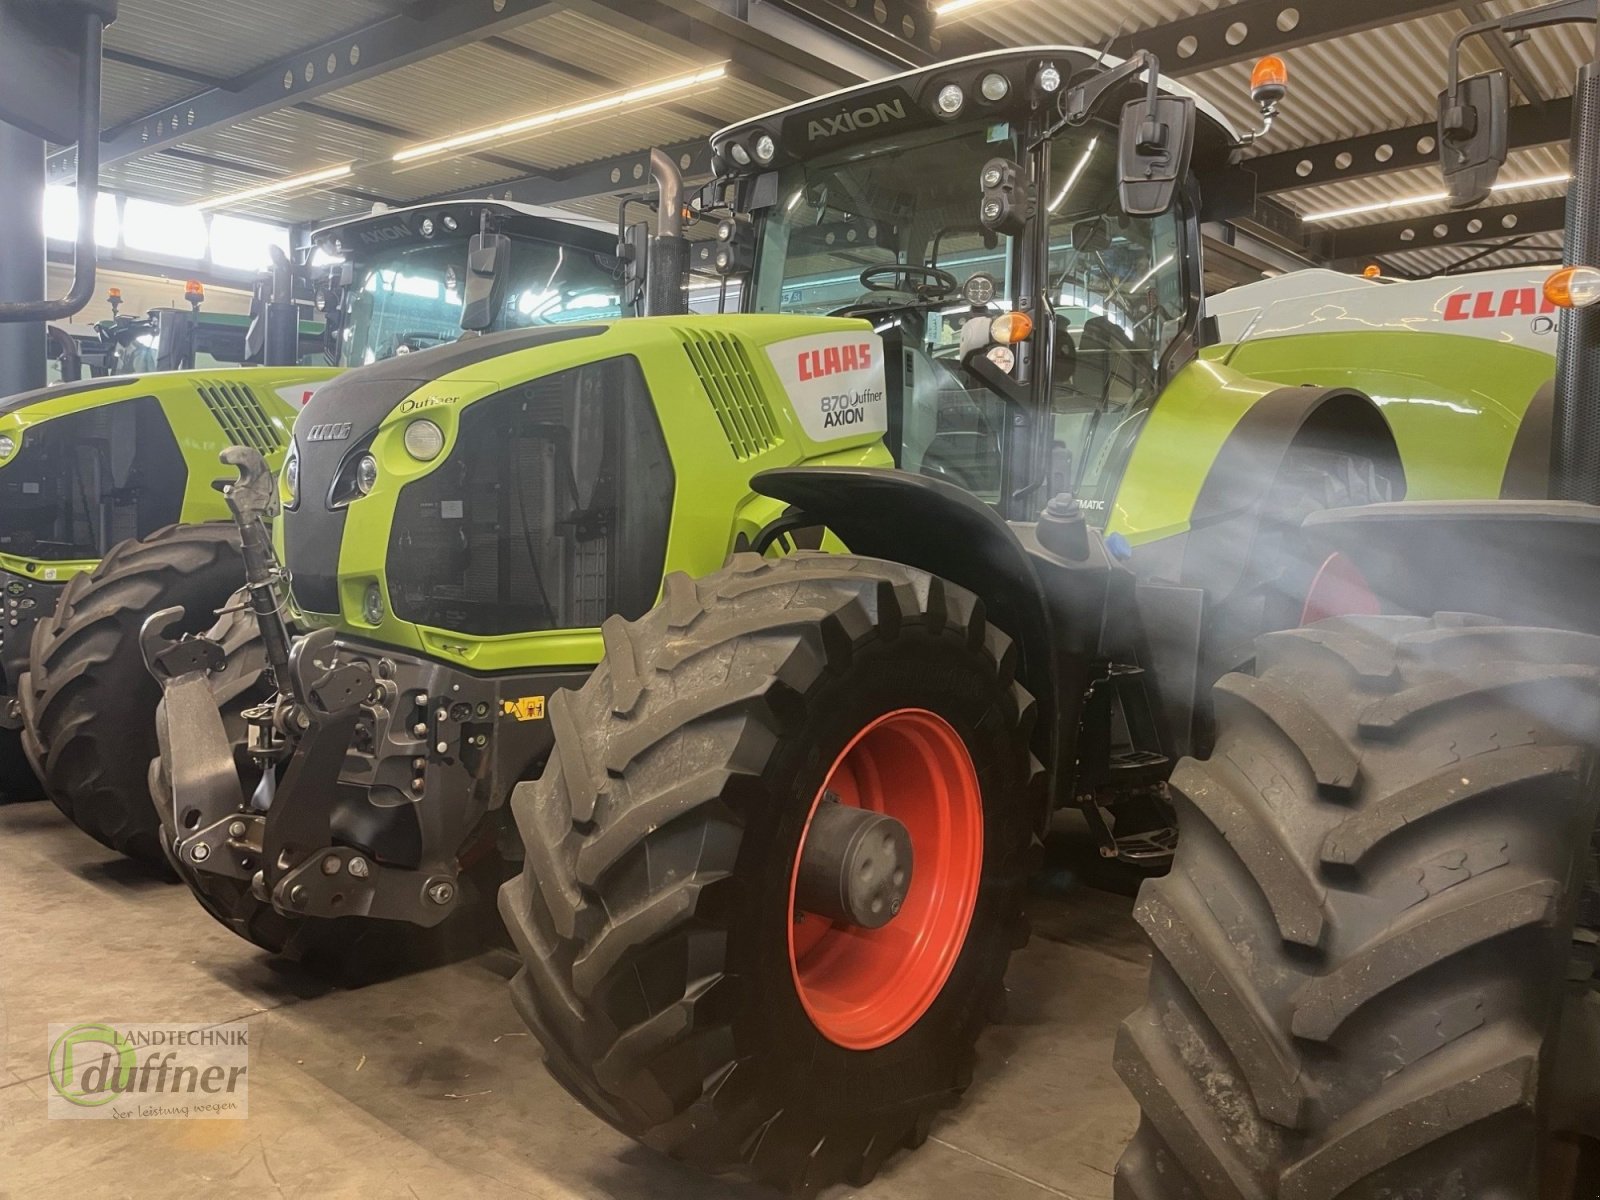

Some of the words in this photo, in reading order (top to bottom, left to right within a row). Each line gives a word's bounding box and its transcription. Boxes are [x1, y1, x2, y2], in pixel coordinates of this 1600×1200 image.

[807, 99, 906, 141] AXION
[1443, 287, 1556, 321] CLA
[798, 343, 871, 381] CLAAS
[821, 394, 849, 412] 870
[824, 407, 864, 428] AXION
[1075, 499, 1105, 510] MATIC
